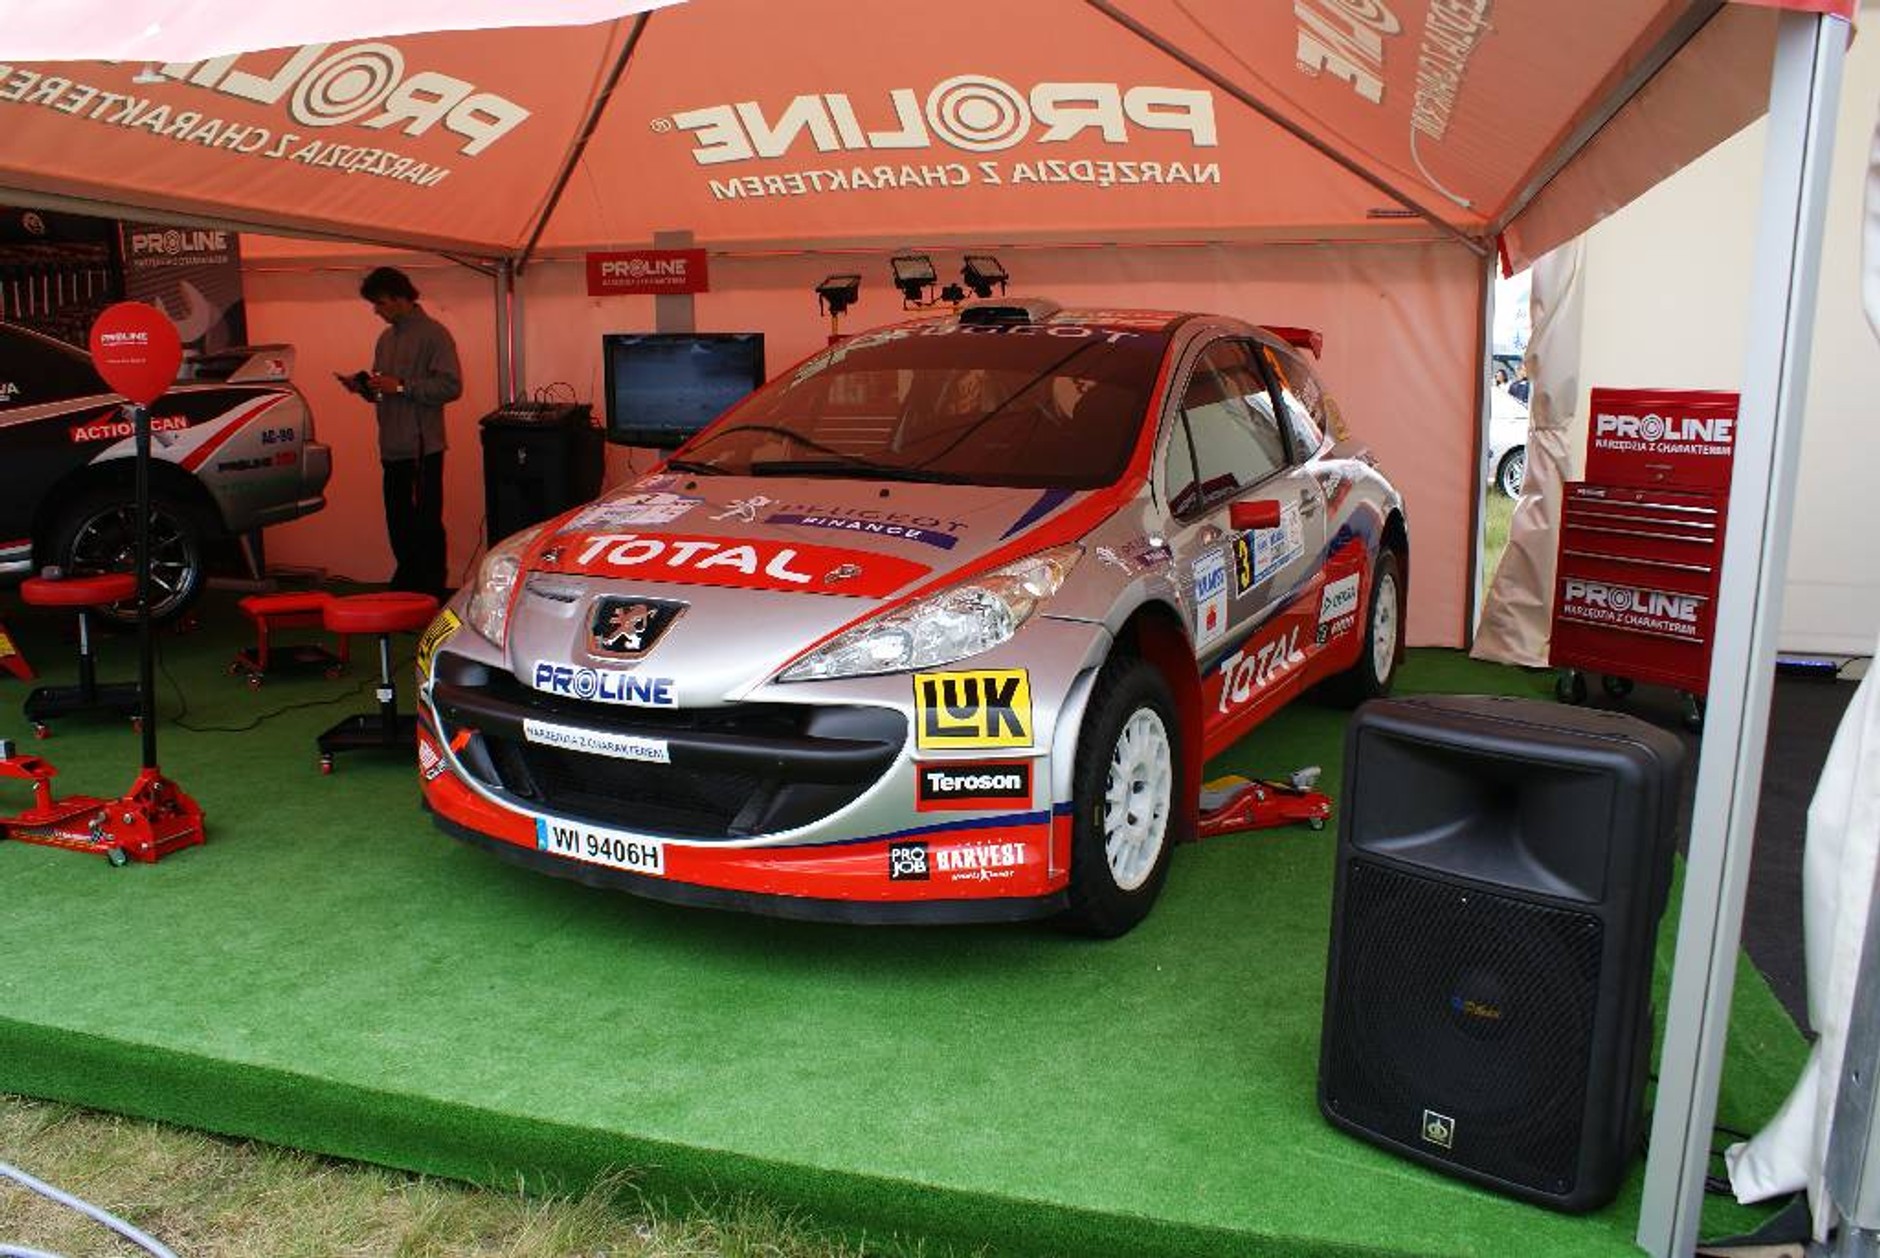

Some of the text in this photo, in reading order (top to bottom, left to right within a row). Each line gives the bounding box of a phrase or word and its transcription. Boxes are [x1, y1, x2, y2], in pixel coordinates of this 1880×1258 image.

[132, 229, 227, 254] PROLINE
[602, 258, 687, 277] PROLINE
[1596, 414, 1733, 442] PROLINE
[576, 533, 813, 584] TOTAL
[1238, 539, 1250, 589] 3
[1565, 580, 1698, 621] PROLINE
[535, 663, 674, 704] PROLINE
[1219, 625, 1306, 714] TOTAL
[927, 772, 1021, 793] Teroson
[553, 826, 659, 868] WI 9406H
[892, 847, 926, 862] PRO
[936, 842, 1026, 871] HARVEST
[892, 862, 927, 878] JOB
